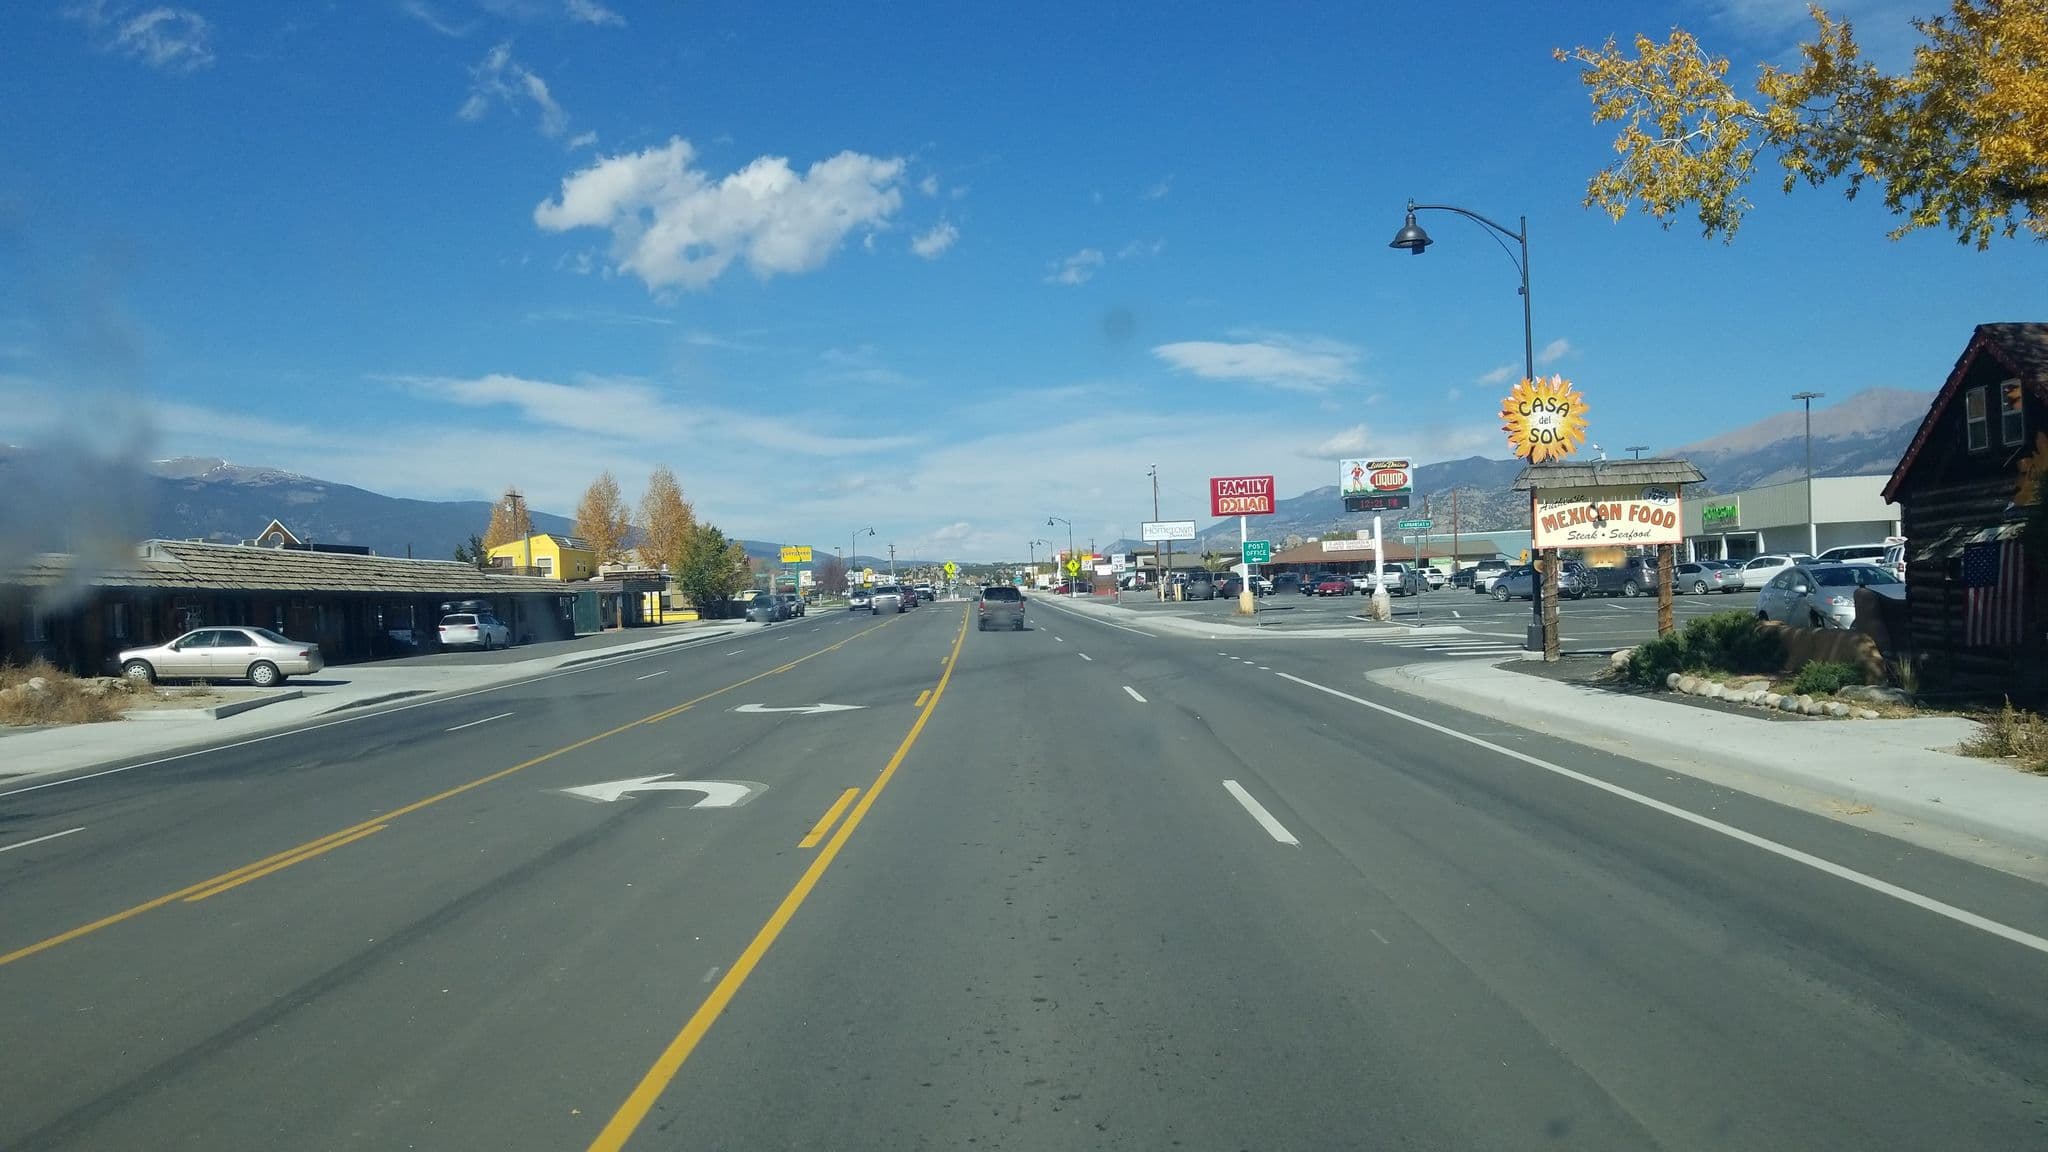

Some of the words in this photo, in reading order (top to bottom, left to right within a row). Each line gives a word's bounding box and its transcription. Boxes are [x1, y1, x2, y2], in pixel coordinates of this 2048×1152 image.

[1518, 397, 1569, 417] CASA
[1538, 416, 1551, 424] del
[1529, 428, 1565, 444] SOL
[1218, 478, 1270, 496] FAMILY
[1375, 472, 1404, 487] LIQUOR
[1219, 496, 1268, 512] DOLLAR
[1540, 495, 1585, 512] Authentic
[1541, 504, 1621, 532] MEXICAN
[1629, 504, 1676, 529] FOOD
[1568, 530, 1598, 541] Steak
[1609, 529, 1651, 540] Seafood
